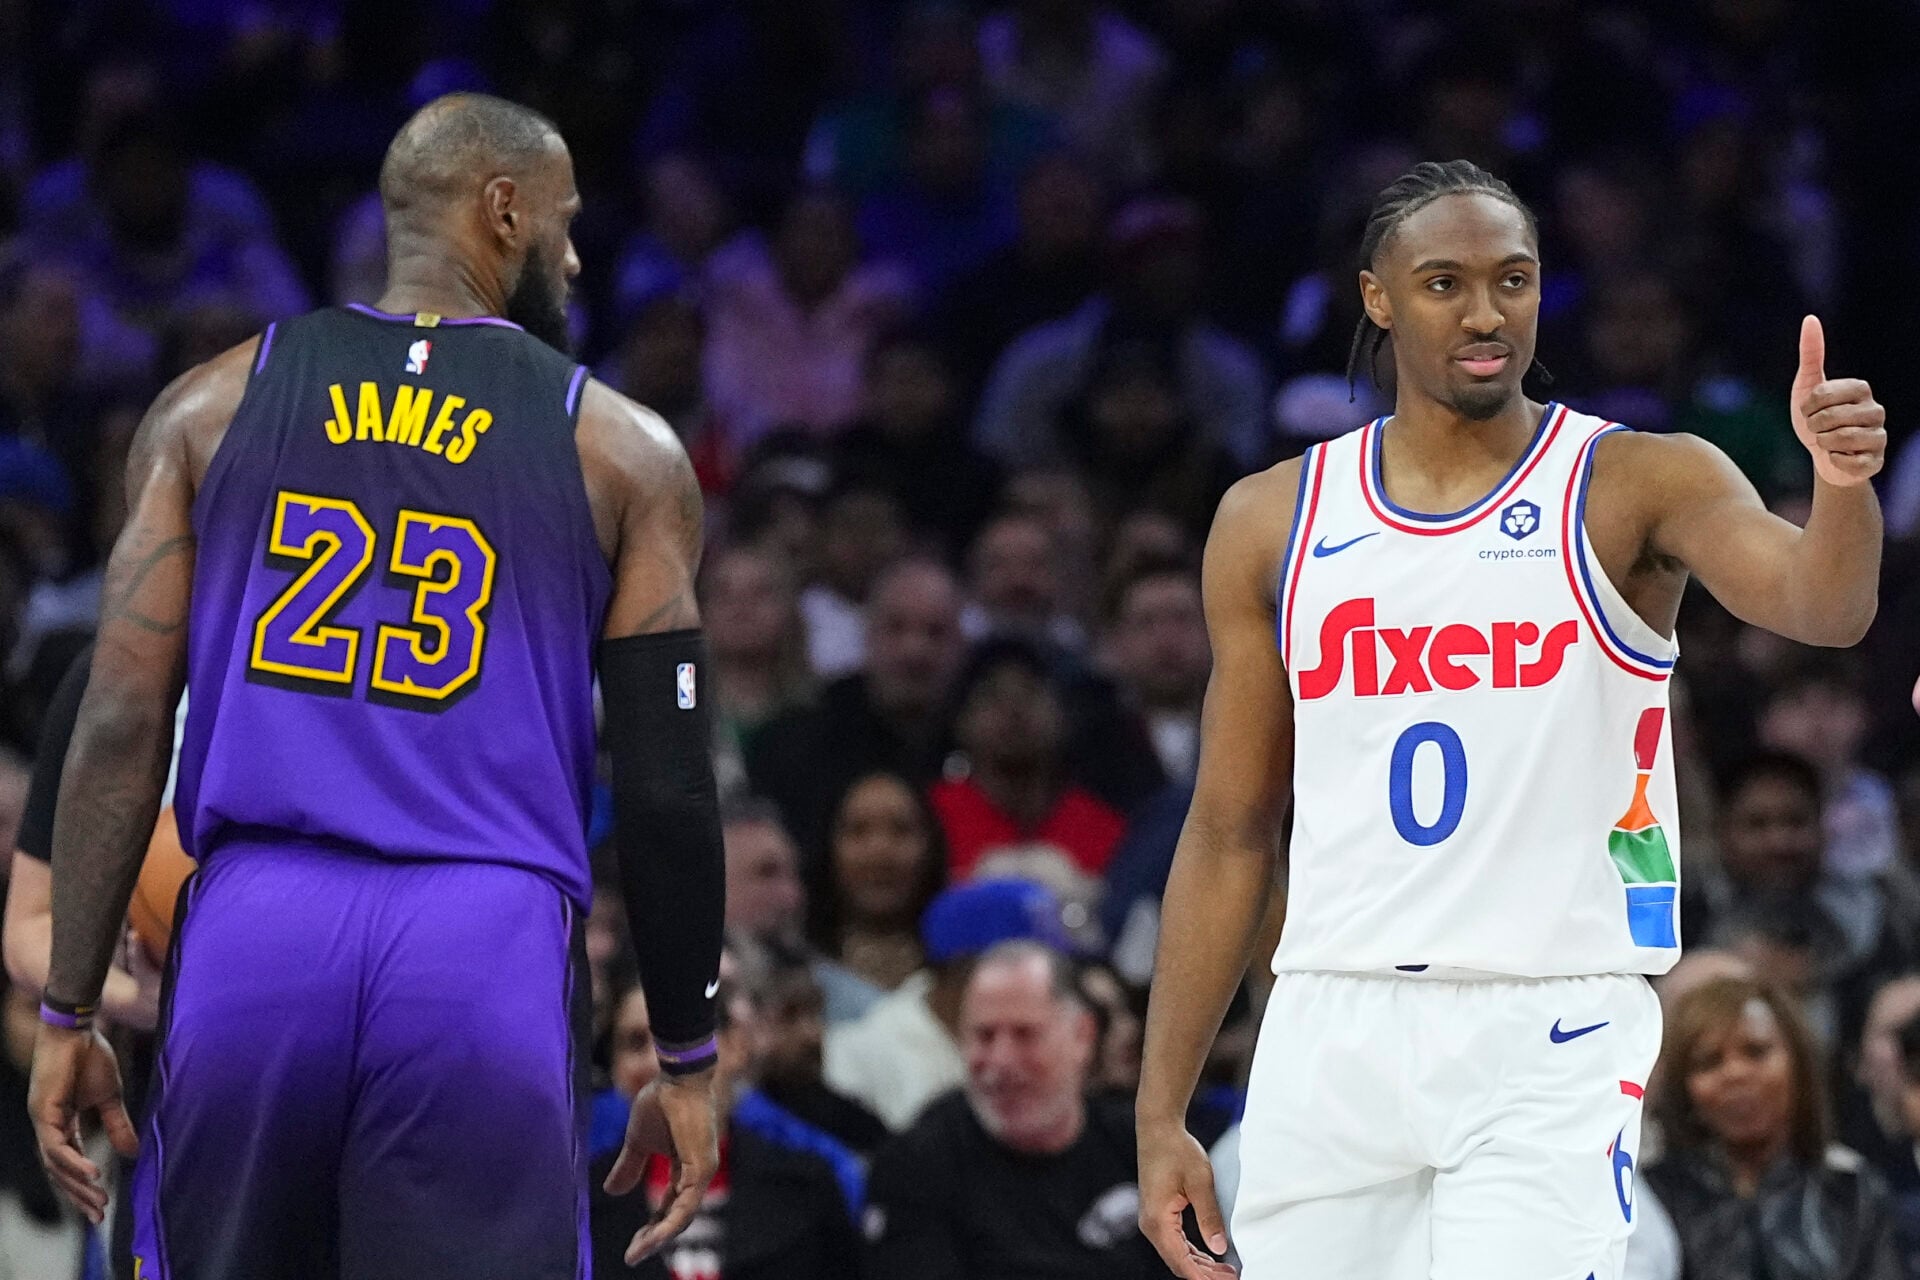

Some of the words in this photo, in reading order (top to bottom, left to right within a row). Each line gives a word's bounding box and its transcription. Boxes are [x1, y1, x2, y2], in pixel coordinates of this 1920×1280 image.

[324, 381, 493, 464] JAMES
[248, 491, 497, 706] 23
[1478, 547, 1557, 561] crypto.com
[1298, 597, 1579, 700] Sixers
[1388, 721, 1468, 847] 0
